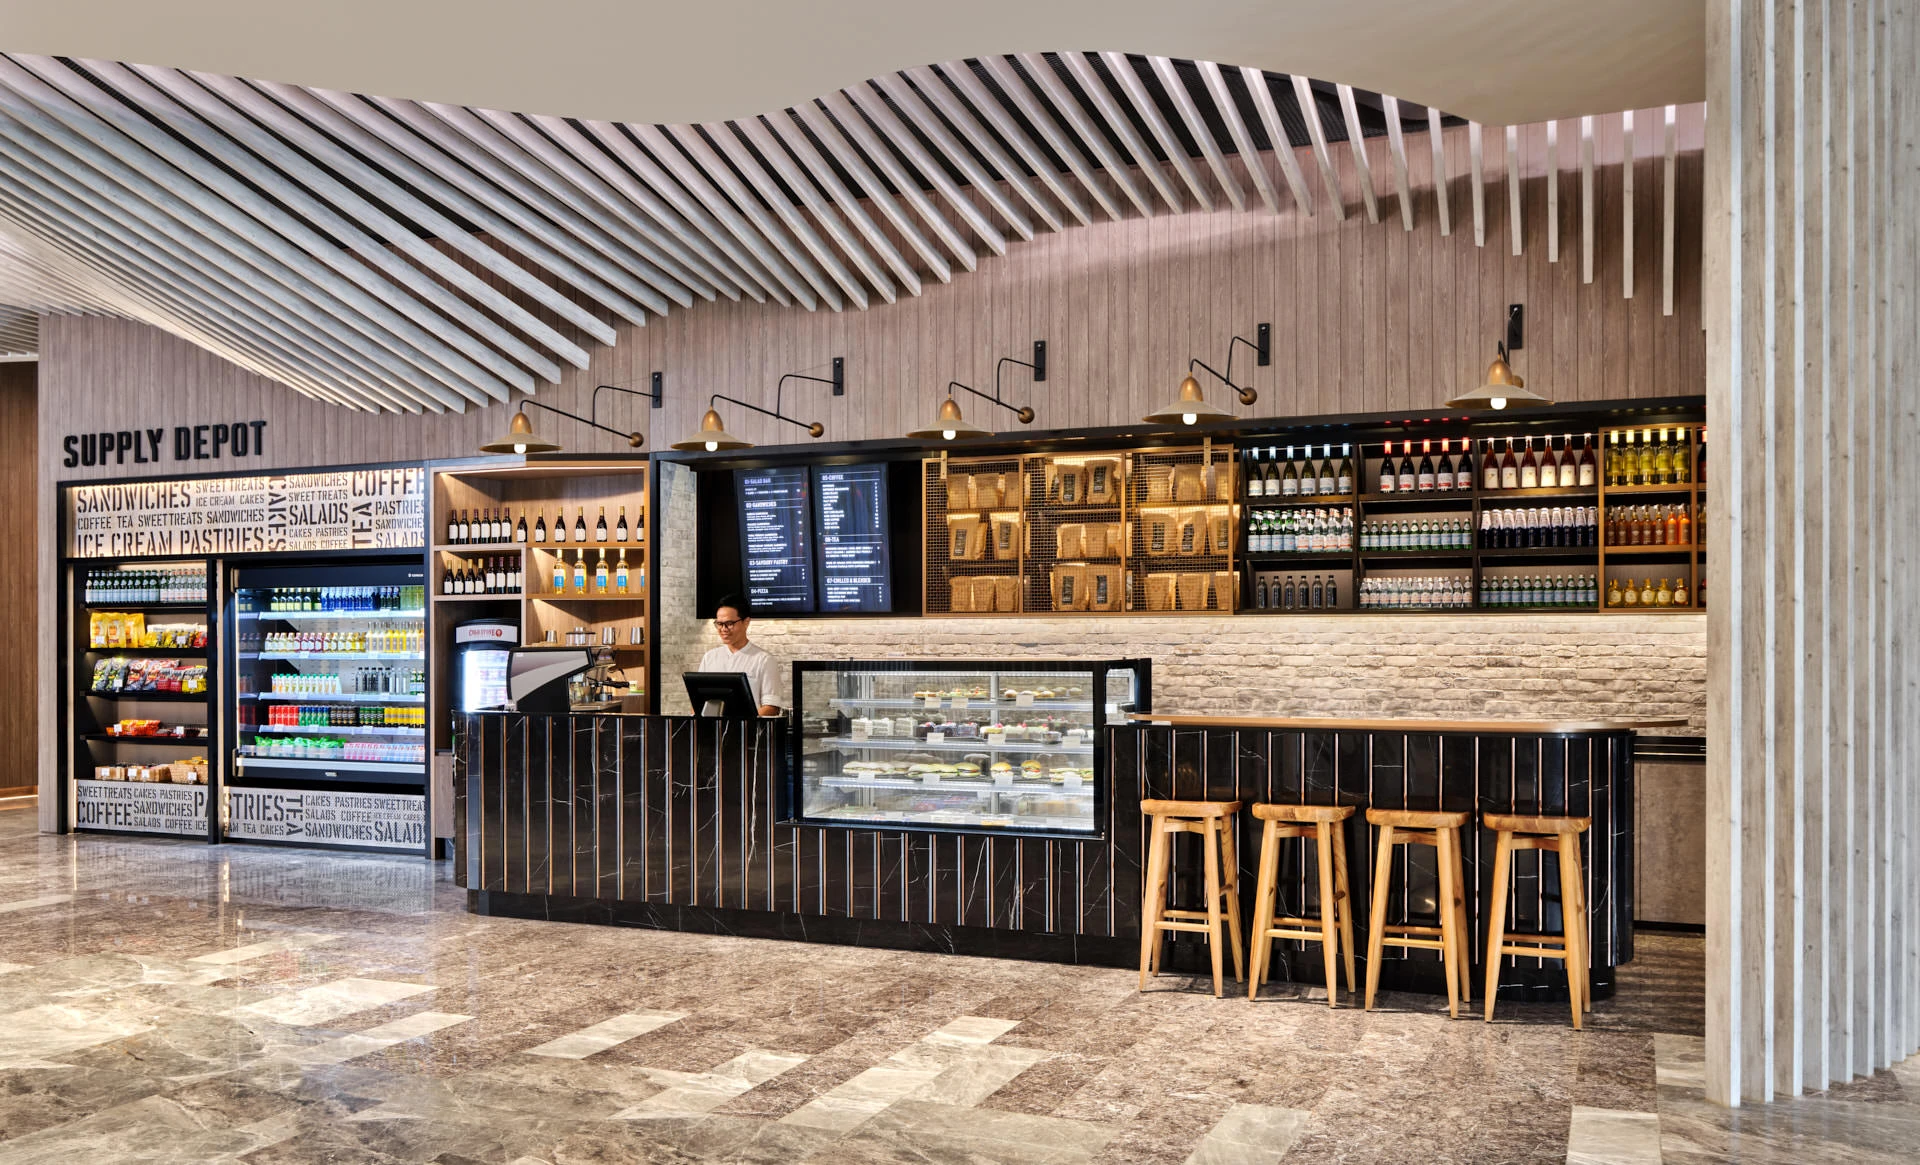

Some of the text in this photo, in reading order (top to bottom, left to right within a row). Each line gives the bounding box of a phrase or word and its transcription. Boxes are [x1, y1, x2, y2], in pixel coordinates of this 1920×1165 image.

[63, 420, 267, 468] SUPPLY DEPOT
[196, 476, 265, 494] SWEET TREATS
[289, 473, 348, 489] SANDWICHES
[77, 483, 191, 513] SANDWICHES
[196, 494, 265, 507] ICE CREAM CAKES
[289, 489, 348, 502] SWEET TREATS
[77, 508, 265, 530] COFFEE TEA SWEET TREATS SANDWICHES
[268, 476, 286, 552] CAKES
[289, 502, 349, 526] SALADS
[288, 526, 348, 538] CAKES PASTRIES
[352, 502, 372, 549] TEA
[375, 518, 424, 530] SANDWICHE
[77, 526, 265, 558] ICE CREAM PASTRIES
[288, 540, 348, 550] SALADS COFFEE
[78, 786, 132, 799] SWEET TREATS
[134, 788, 193, 801] CAKES PASTRIES
[133, 800, 193, 817] SANDWICHES
[305, 794, 331, 807] CAKES
[334, 796, 372, 809] PASTRIES
[374, 798, 400, 811] SWEET
[78, 800, 132, 826] COFFEE
[286, 794, 303, 836] TEA
[305, 808, 372, 823] SALADS COFFEE
[134, 816, 207, 831] SALADS COFFEE ICE
[242, 823, 256, 834] TEA
[260, 823, 284, 836] CAKES
[304, 821, 373, 842] SANDWICHES
[374, 820, 425, 844] SALAD
